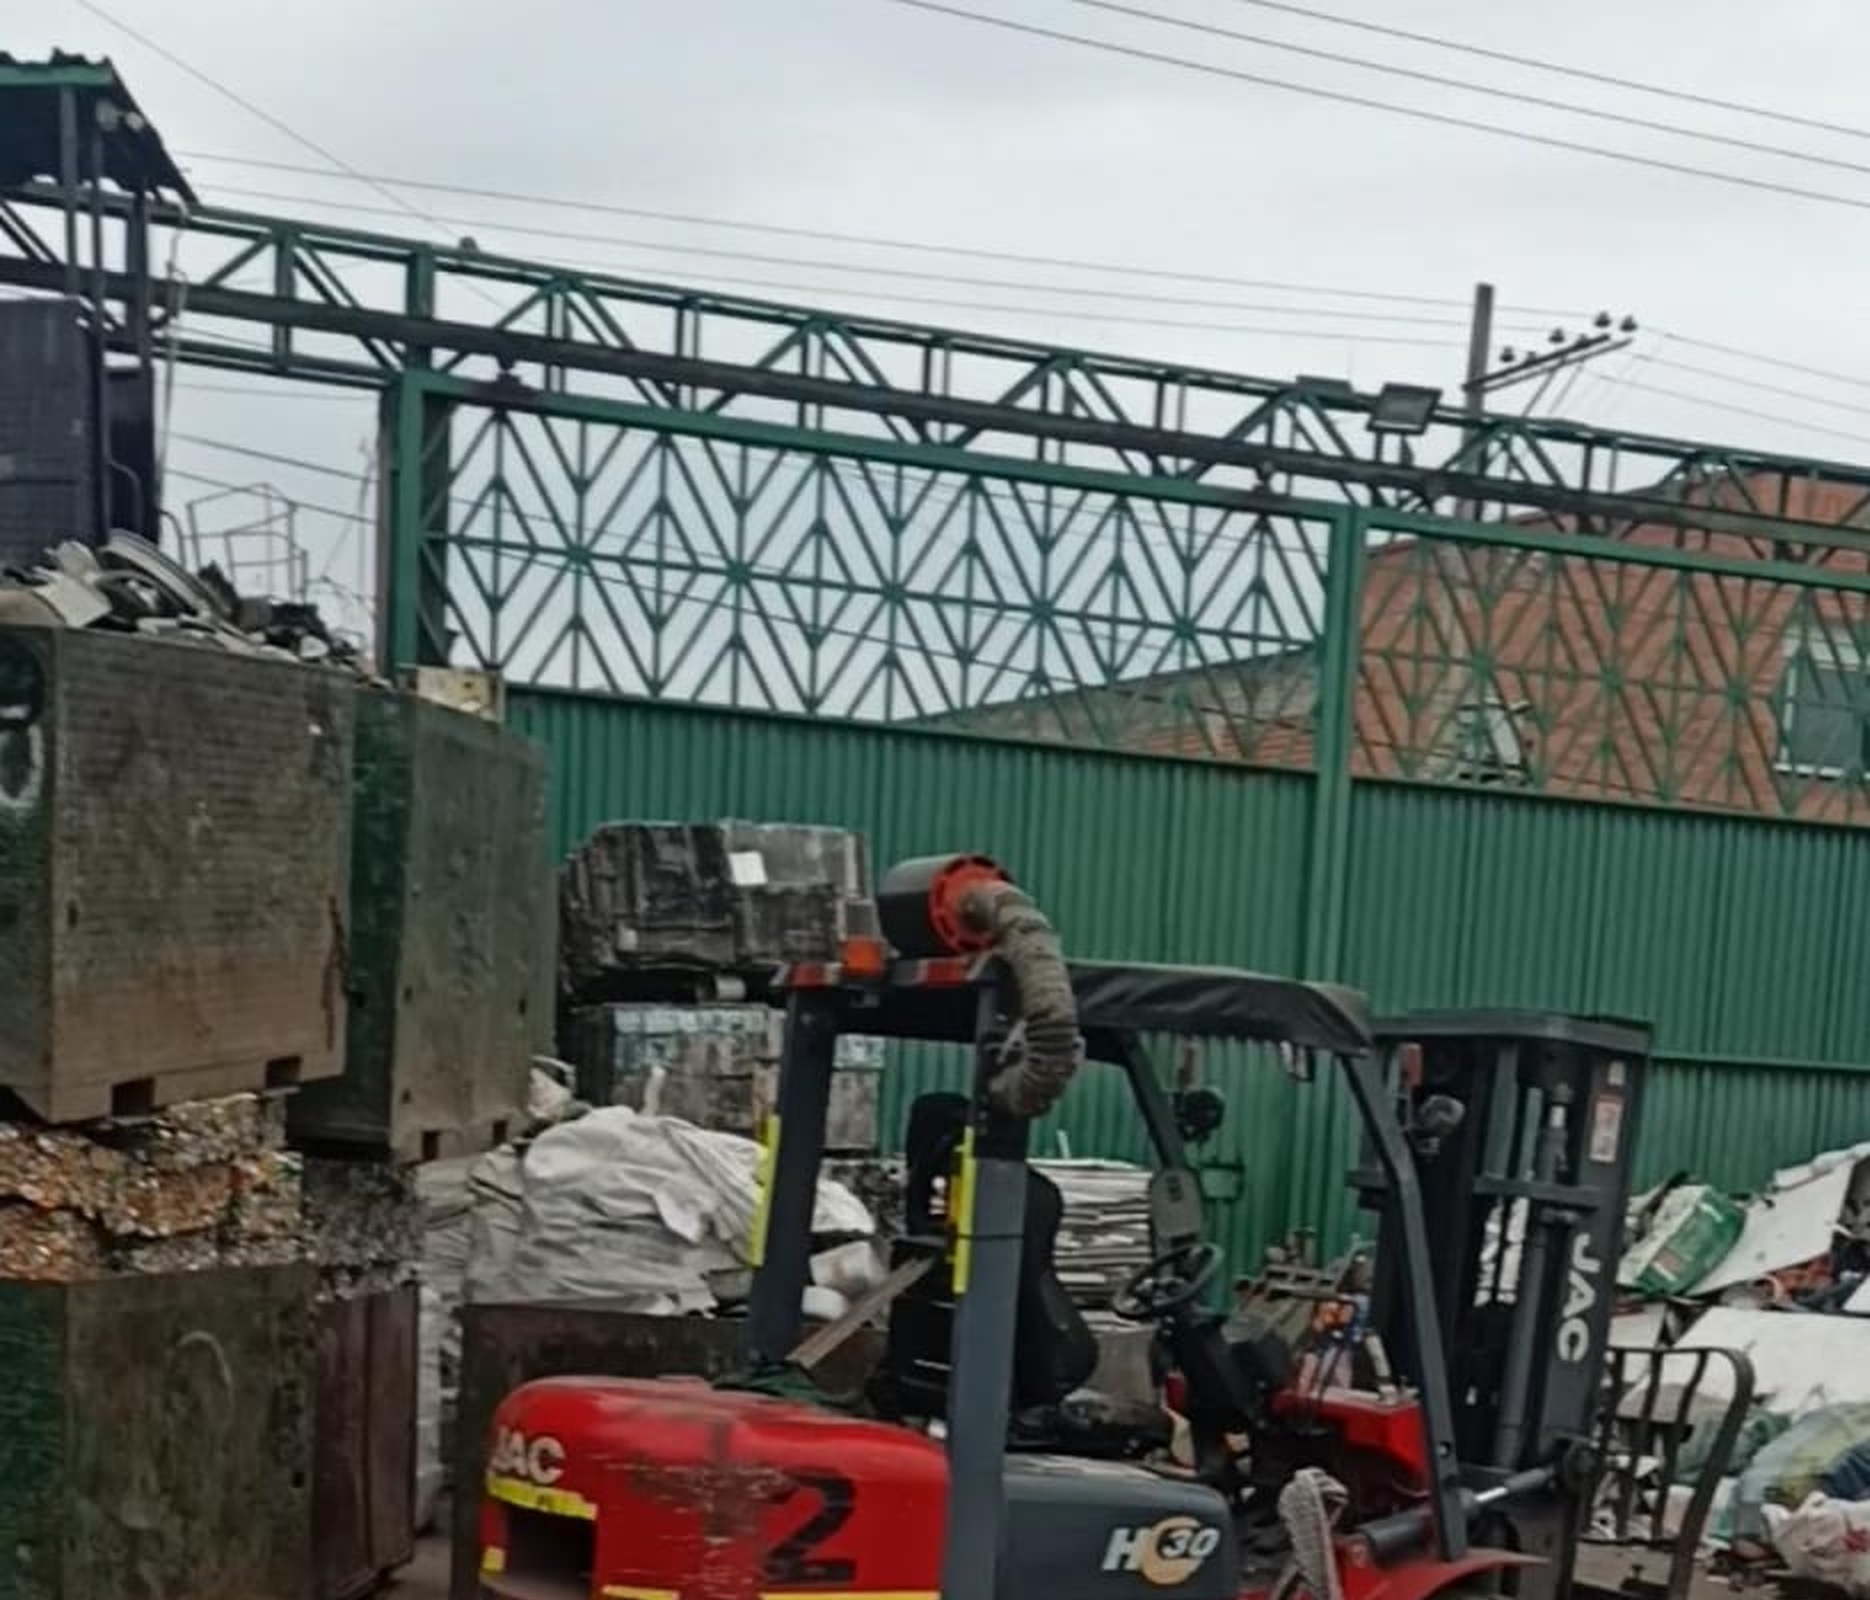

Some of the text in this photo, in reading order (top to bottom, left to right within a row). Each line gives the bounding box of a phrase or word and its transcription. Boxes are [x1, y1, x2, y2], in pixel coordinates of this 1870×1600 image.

[1557, 1233, 1600, 1362] JAC
[491, 1426, 566, 1485] JAC
[764, 1474, 856, 1586] 2
